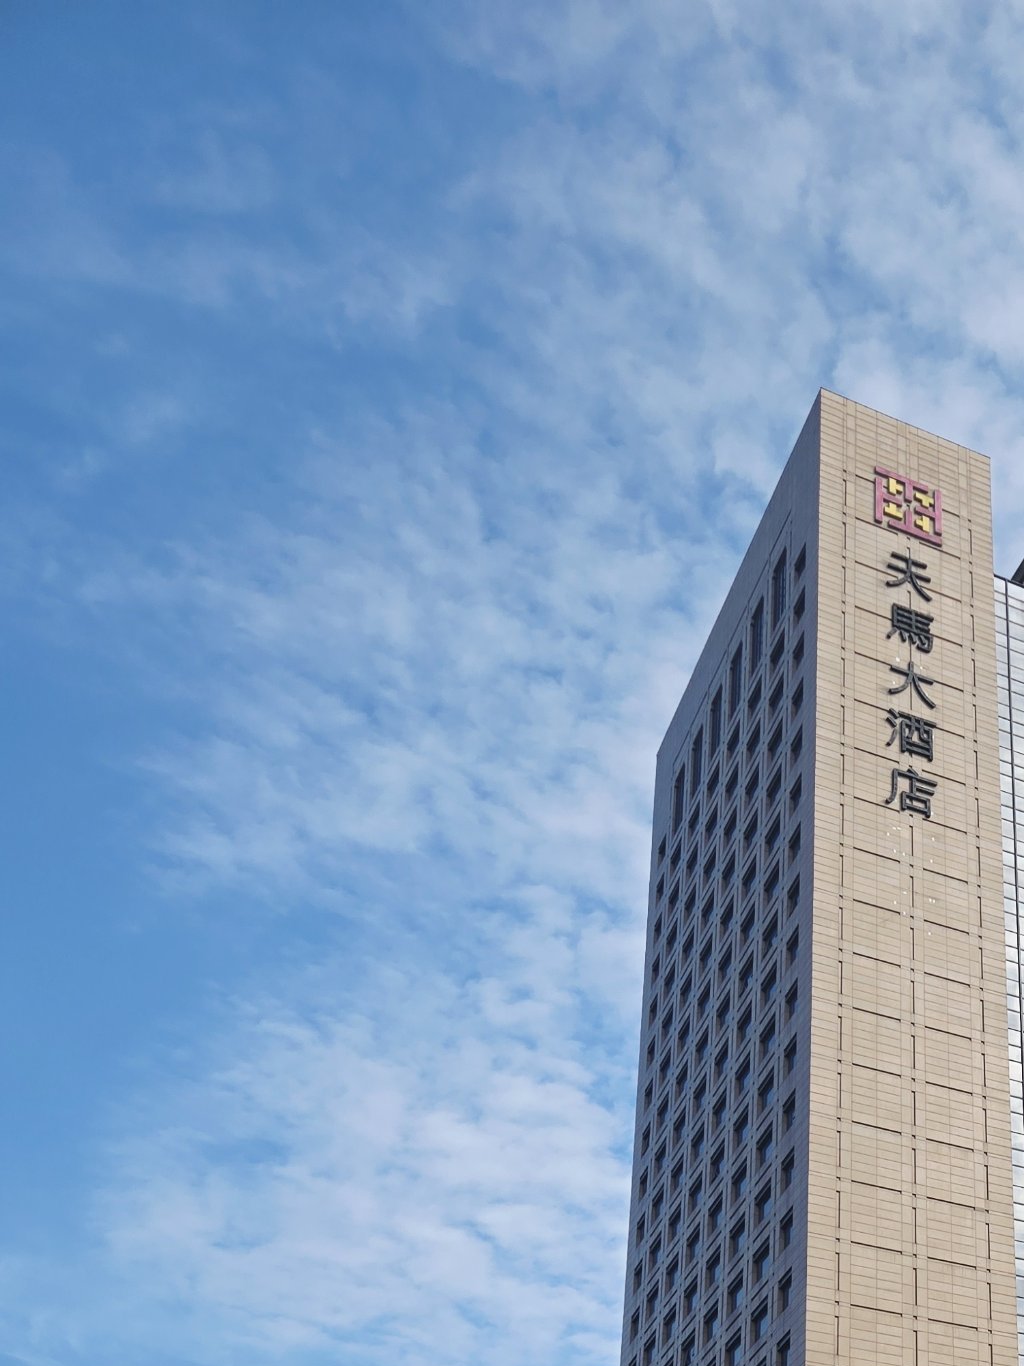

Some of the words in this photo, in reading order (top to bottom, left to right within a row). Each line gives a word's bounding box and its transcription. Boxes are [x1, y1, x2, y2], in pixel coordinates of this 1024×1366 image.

[885, 551, 938, 819] 天馬大酒店
